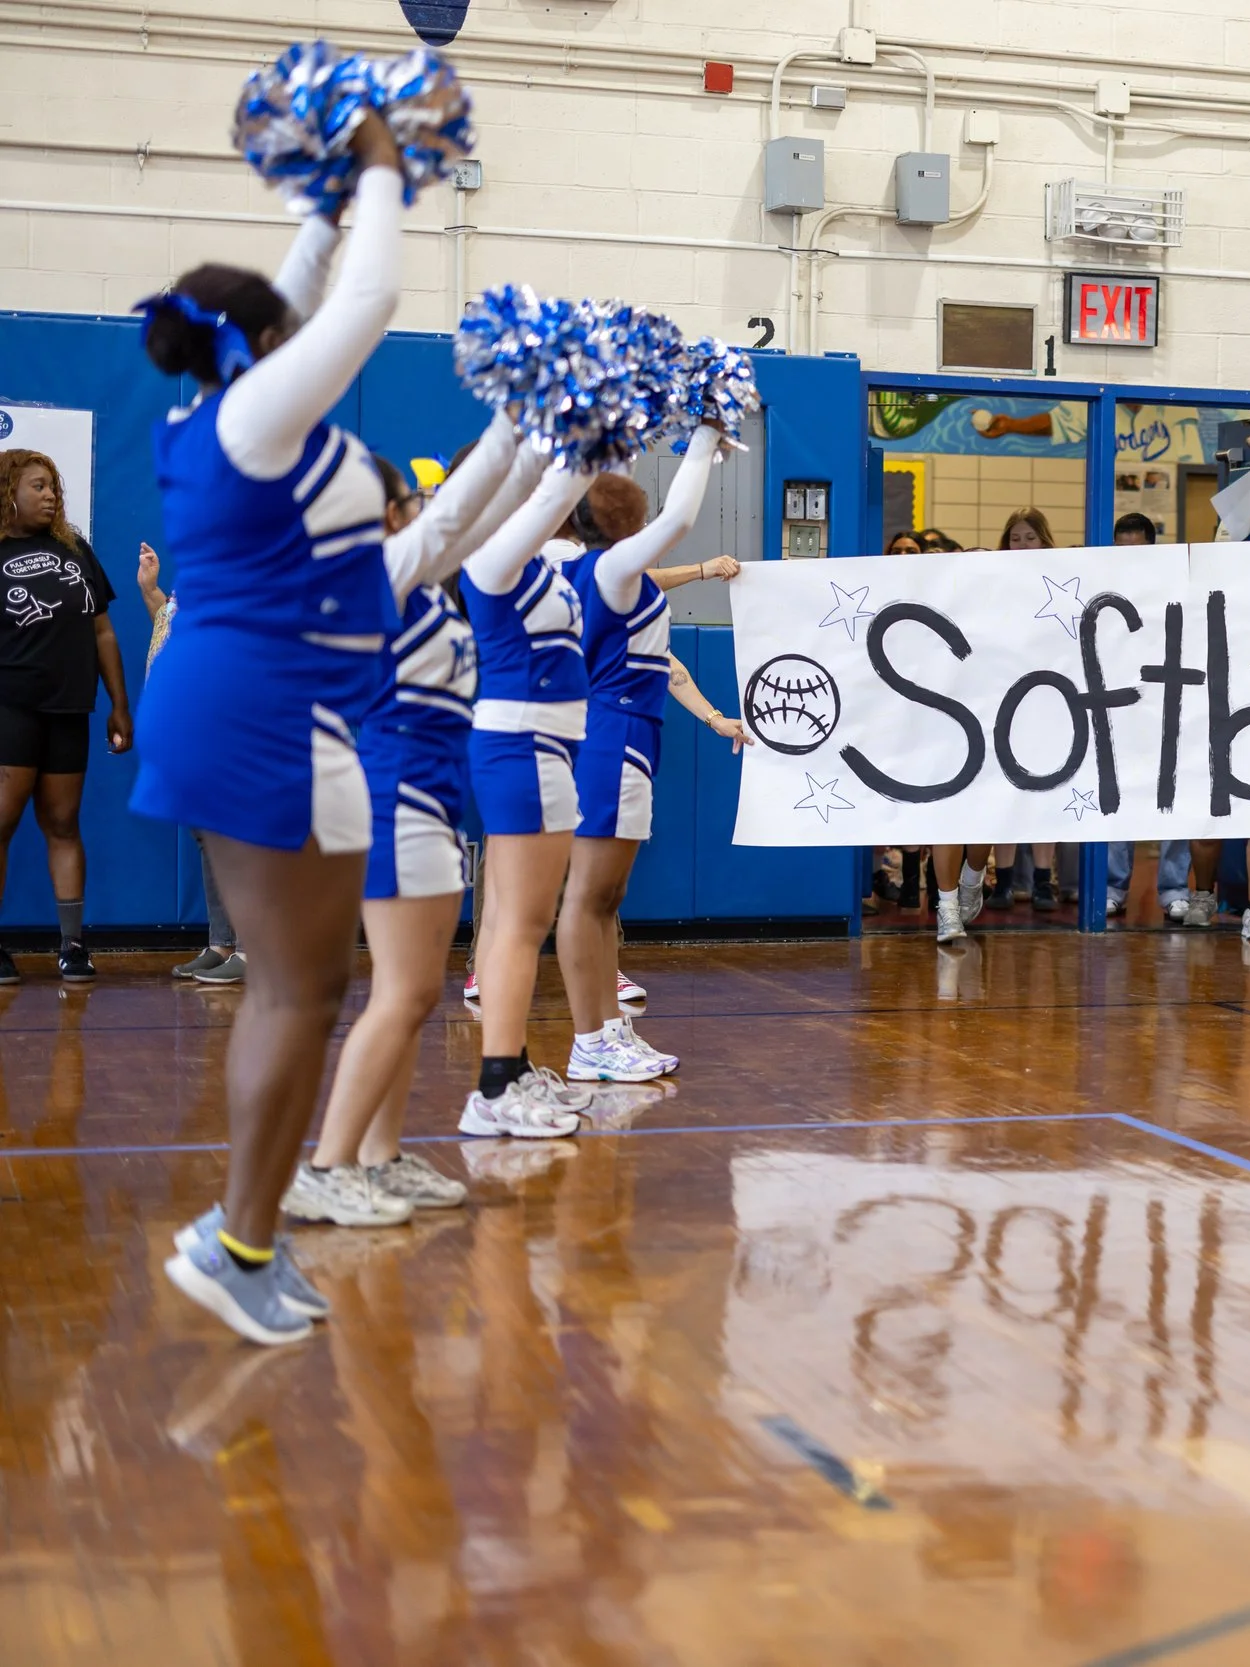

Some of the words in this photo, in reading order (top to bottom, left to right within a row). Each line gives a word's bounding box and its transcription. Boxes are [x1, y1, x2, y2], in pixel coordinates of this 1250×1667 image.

[747, 317, 775, 348] 2
[1079, 283, 1153, 341] EXIT
[1044, 335, 1057, 376] 1
